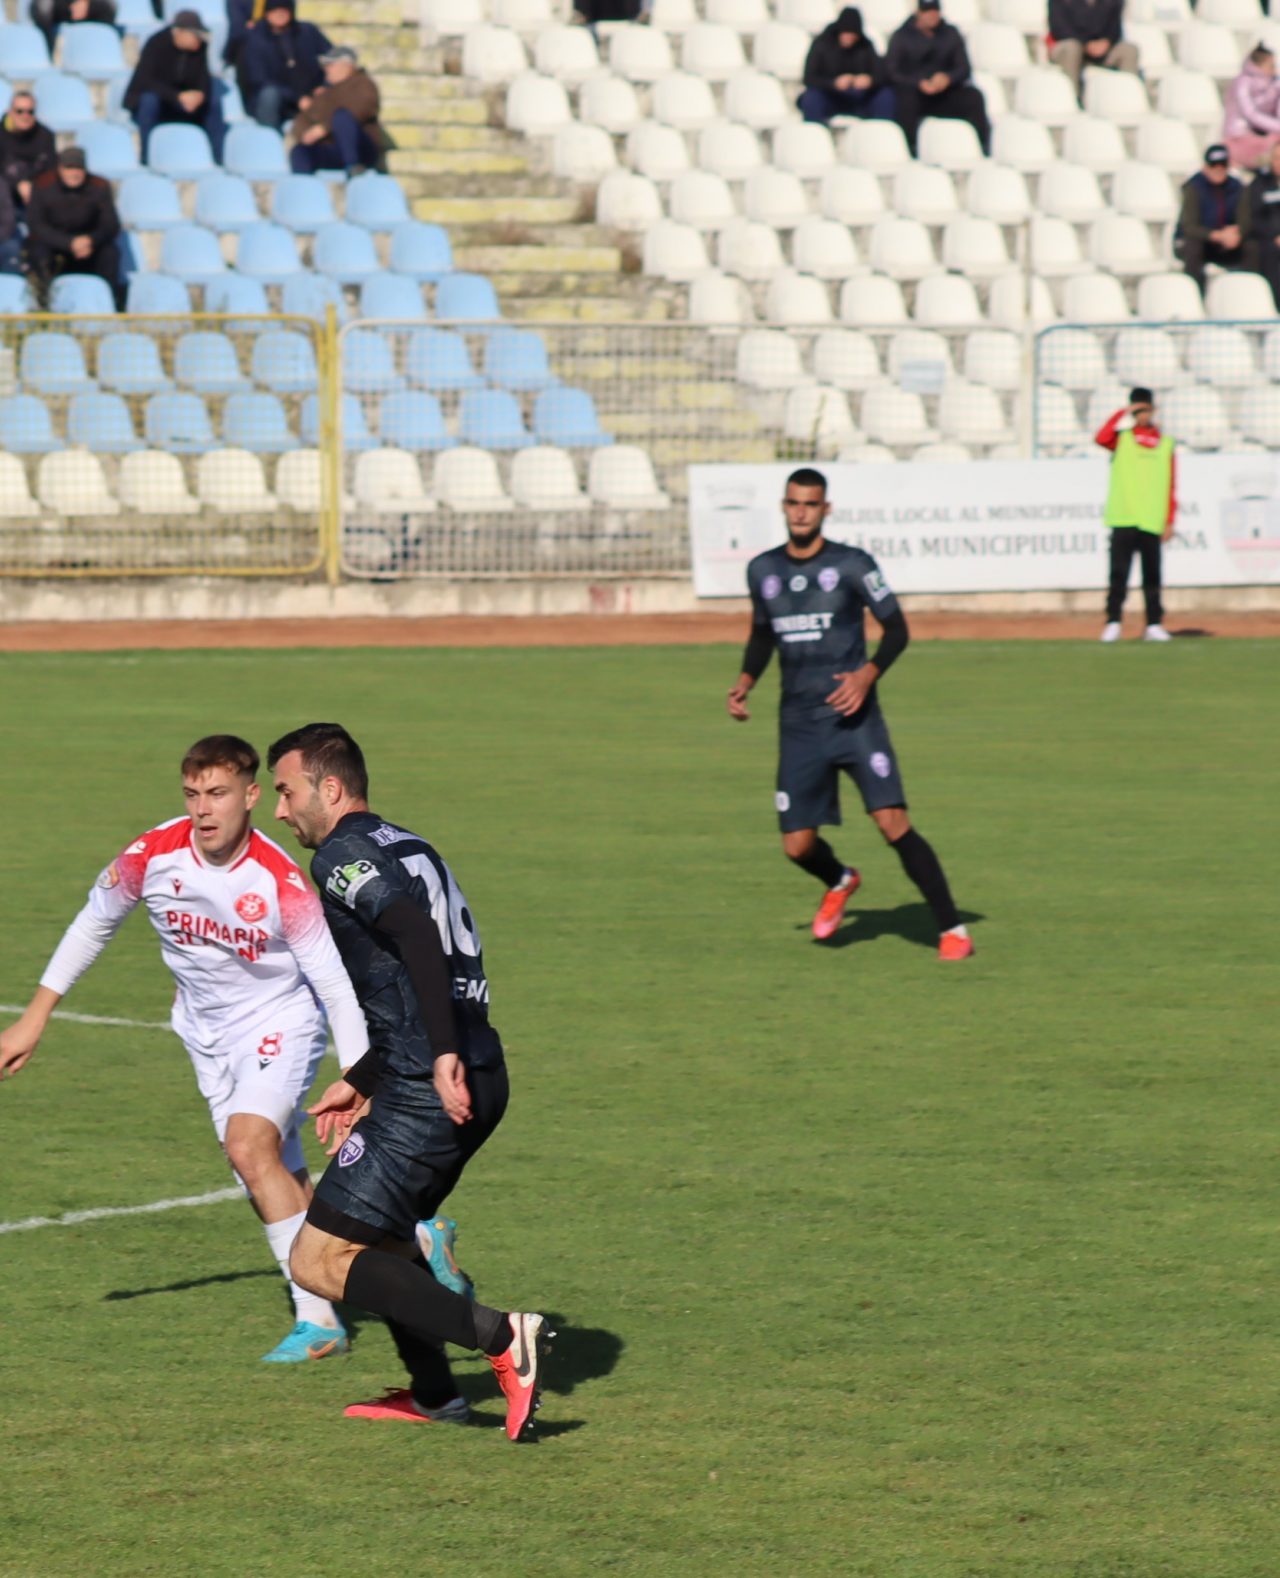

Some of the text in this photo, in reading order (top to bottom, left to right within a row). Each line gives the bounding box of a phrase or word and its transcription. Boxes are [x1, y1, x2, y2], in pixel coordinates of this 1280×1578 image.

[892, 504, 953, 523] LOCAL
[958, 504, 981, 522] AL
[919, 534, 1097, 557] MUNICIPIULUI
[257, 1031, 283, 1057] 8
